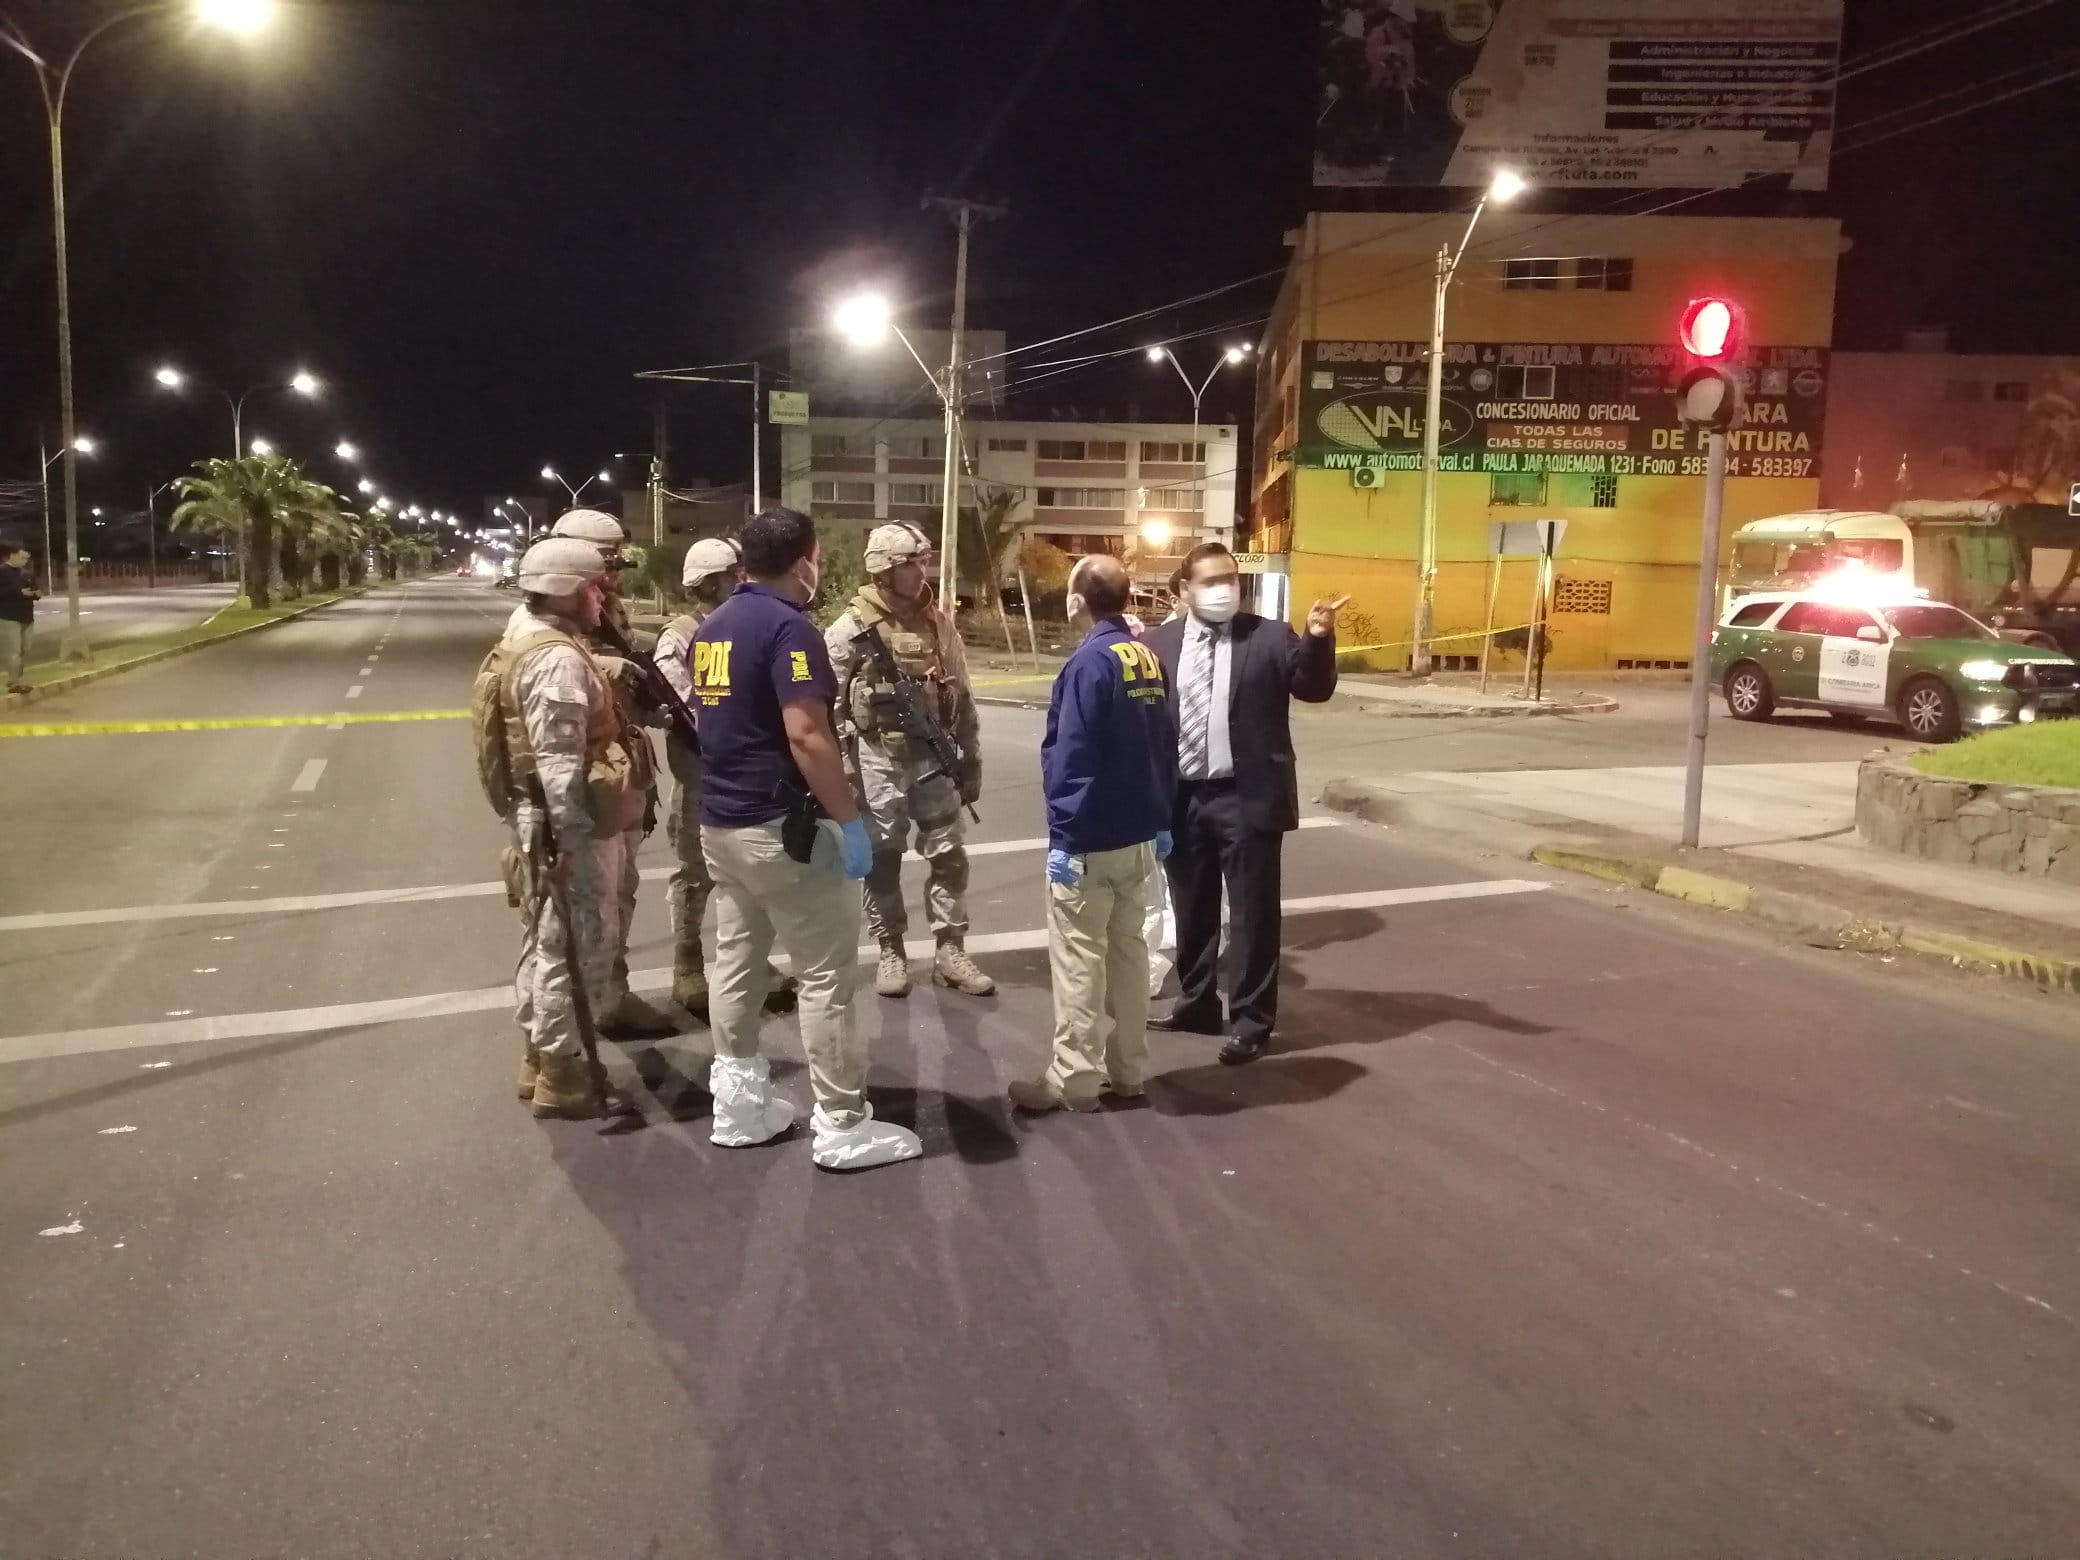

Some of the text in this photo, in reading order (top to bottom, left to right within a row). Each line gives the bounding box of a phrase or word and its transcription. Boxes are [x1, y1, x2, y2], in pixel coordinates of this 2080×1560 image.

[1500, 345, 1583, 365] PINTURA
[1350, 405, 1419, 438] VAL
[1476, 402, 1641, 421] CONCESIONARIO OFICIAL
[1513, 425, 1604, 437] TODAS LAS
[1651, 428, 1811, 452] DE PNTURA
[1526, 438, 1546, 449] DE
[1552, 439, 1628, 450] SEGUROS
[1482, 453, 1518, 472] PAULA
[1521, 453, 1606, 473] JARAQUEMADA
[1751, 457, 1812, 477] 583397
[694, 641, 733, 686] PDI
[790, 650, 810, 677] PDI
[1109, 641, 1163, 682] PDI
